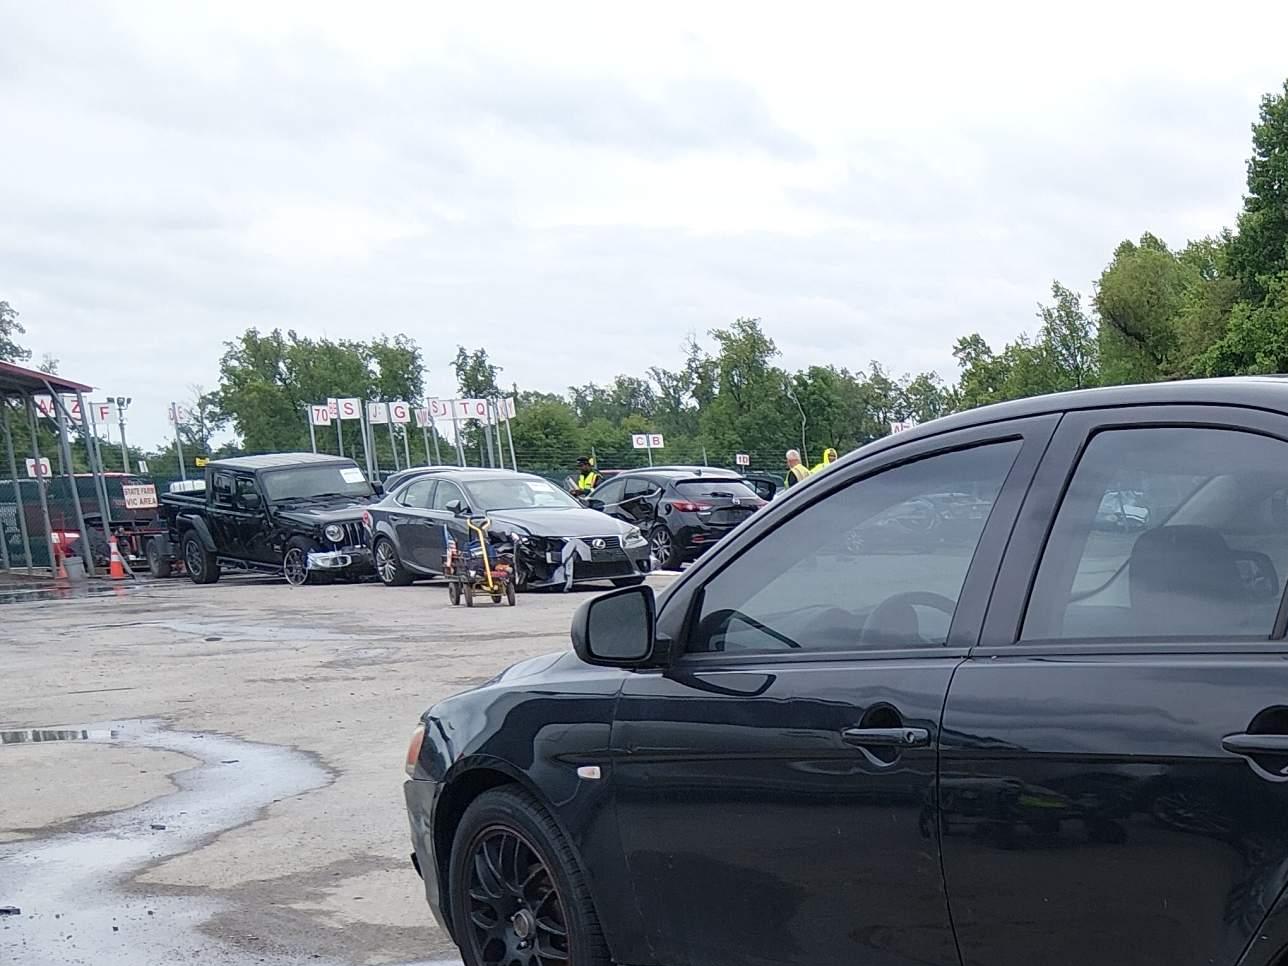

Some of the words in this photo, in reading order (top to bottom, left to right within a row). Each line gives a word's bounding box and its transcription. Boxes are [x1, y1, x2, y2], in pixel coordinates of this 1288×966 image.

[99, 406, 109, 421] F
[343, 402, 354, 416] S
[394, 405, 406, 419] G
[431, 400, 439, 414] S
[441, 403, 447, 416] J
[460, 402, 470, 415] T
[476, 402, 486, 416] Q
[314, 408, 329, 422] 70
[636, 437, 644, 445] C
[652, 436, 661, 445] B
[124, 488, 140, 496] STATE
[140, 497, 156, 505] AREA
